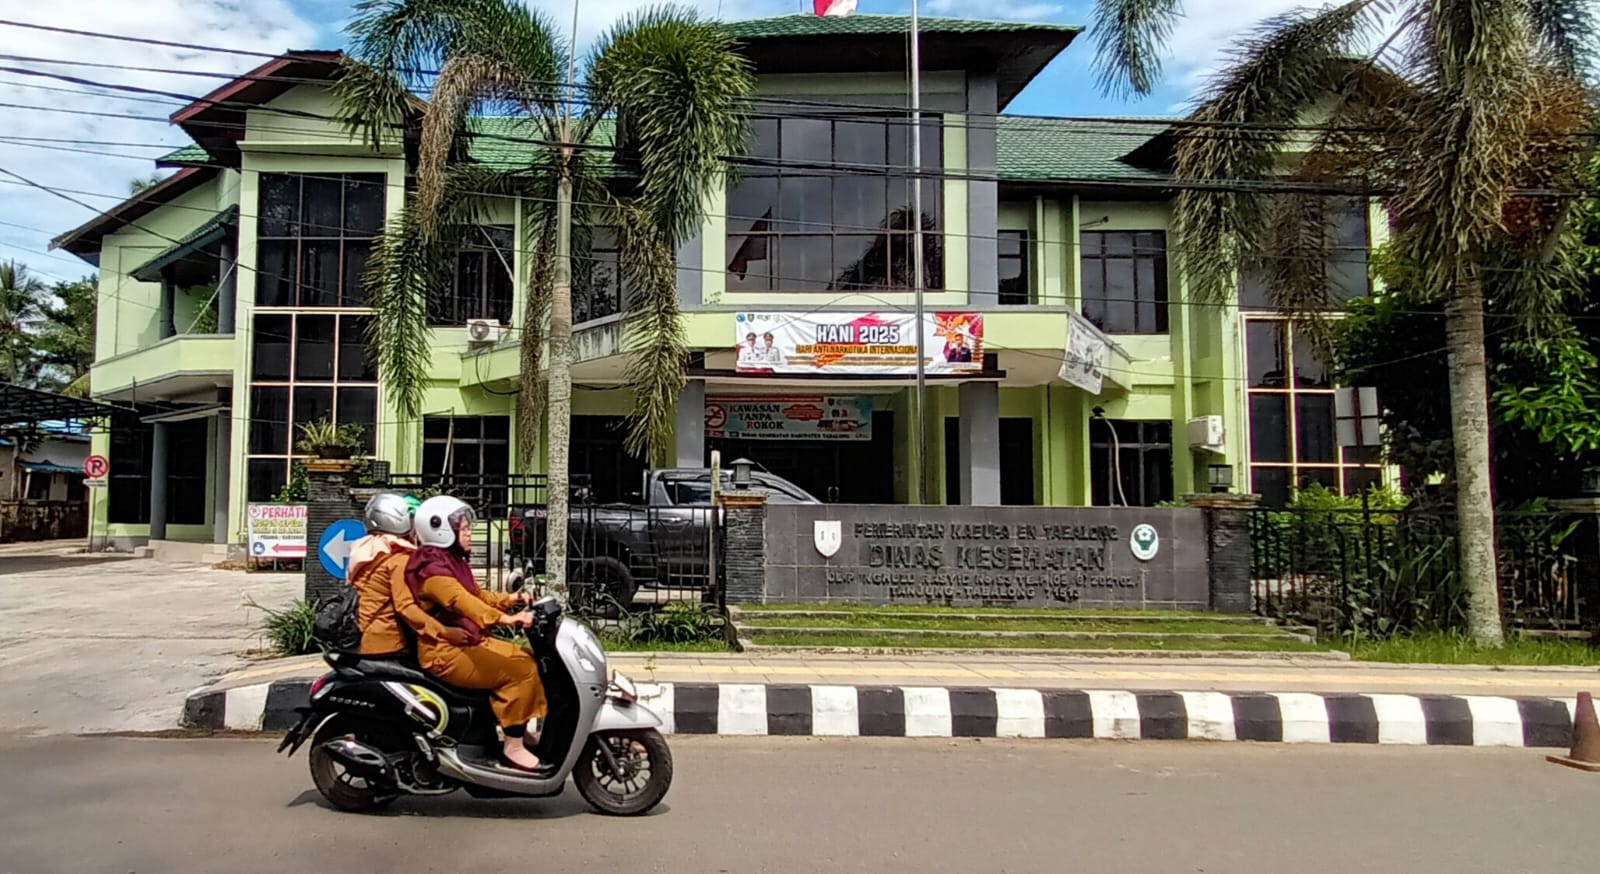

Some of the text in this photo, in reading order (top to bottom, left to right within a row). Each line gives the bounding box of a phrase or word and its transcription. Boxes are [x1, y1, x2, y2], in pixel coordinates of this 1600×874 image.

[816, 323, 900, 344] HANI 2025
[796, 345, 812, 353] HARI
[829, 345, 868, 354] NARKOTIKA
[729, 404, 780, 413] KAWASAN
[739, 412, 773, 421] TANPA
[746, 421, 784, 430] ROKOK
[854, 522, 945, 539] PEMERINTAH
[1042, 524, 1119, 541] TABALONG
[868, 543, 1105, 571] DINAS KESEHATAN
